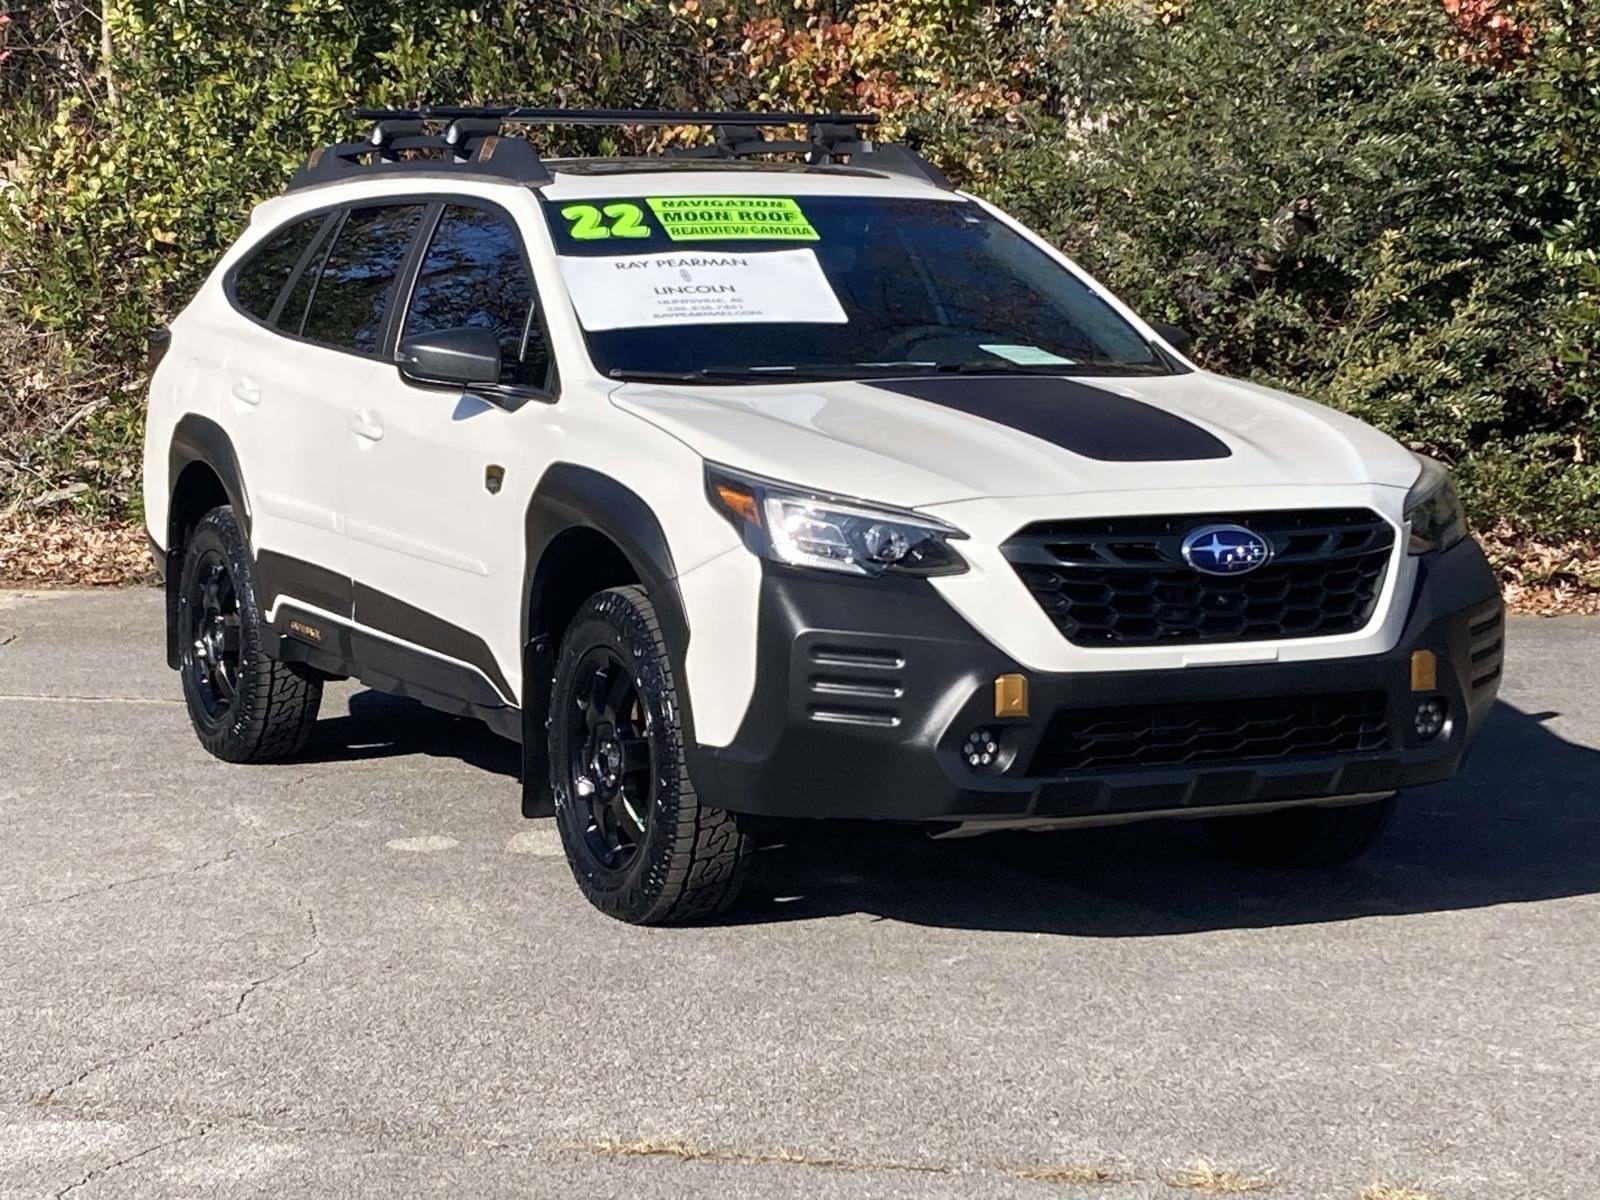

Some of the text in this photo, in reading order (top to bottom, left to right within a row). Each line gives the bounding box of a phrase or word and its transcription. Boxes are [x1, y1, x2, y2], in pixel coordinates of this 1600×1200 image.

[661, 200, 784, 209] NAVIGATION
[561, 203, 651, 239] 22
[662, 211, 797, 222] MOON ROOF
[670, 225, 813, 236] REARVIEW CAMERA
[614, 257, 749, 270] RAY PEARMAN
[653, 284, 737, 296] LINCOLN
